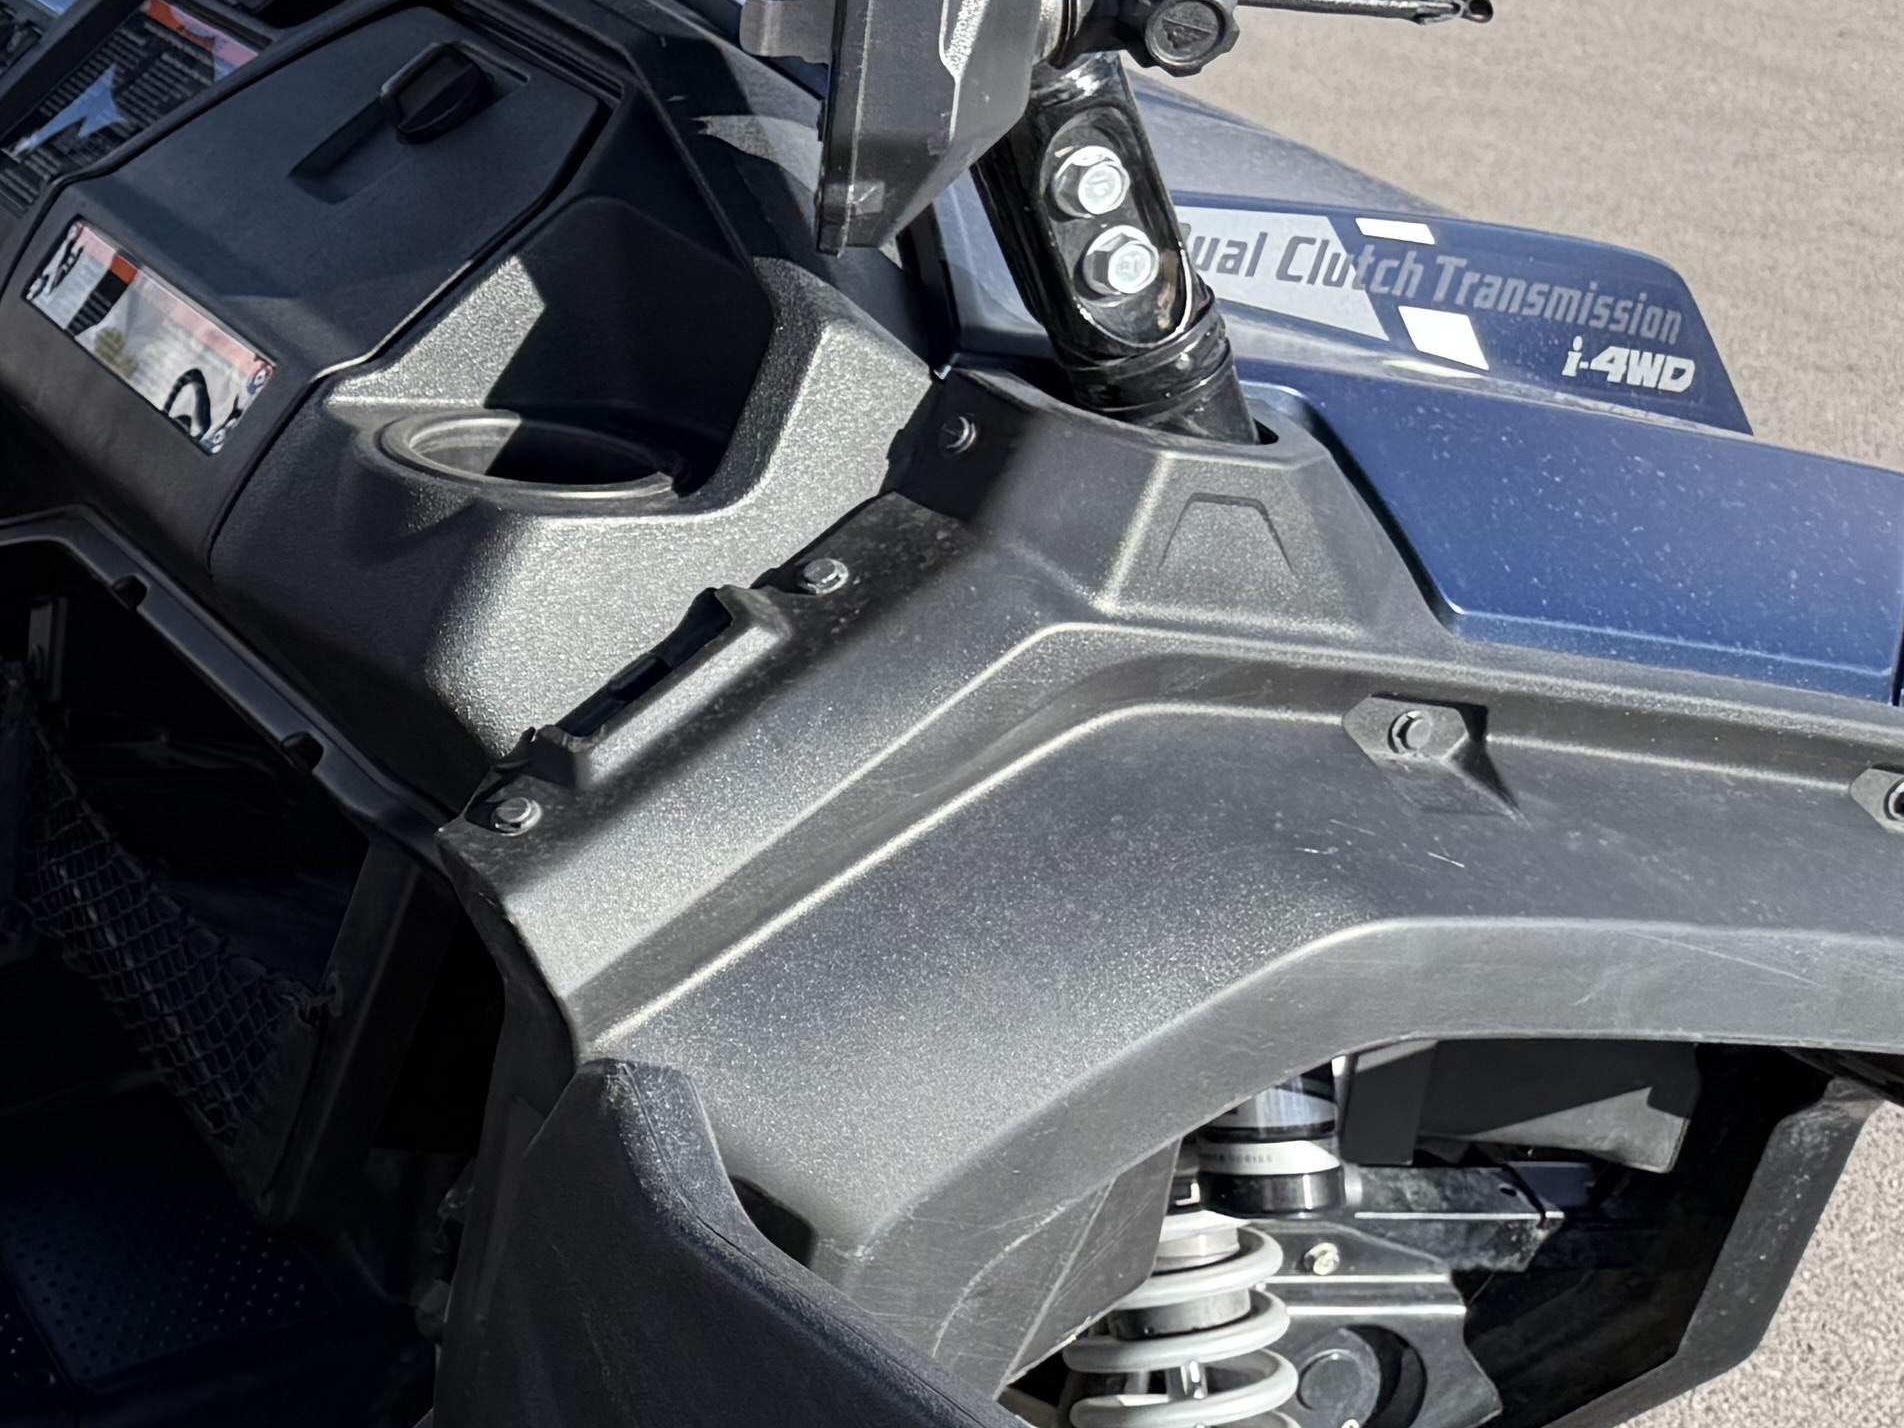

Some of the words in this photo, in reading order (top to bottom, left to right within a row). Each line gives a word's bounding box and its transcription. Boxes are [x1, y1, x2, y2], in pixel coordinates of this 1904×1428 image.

[1177, 222, 1268, 278] ual
[1275, 235, 1424, 299] Clutch
[1433, 255, 1682, 345] Transmission
[1561, 335, 1695, 393] i-4WD
